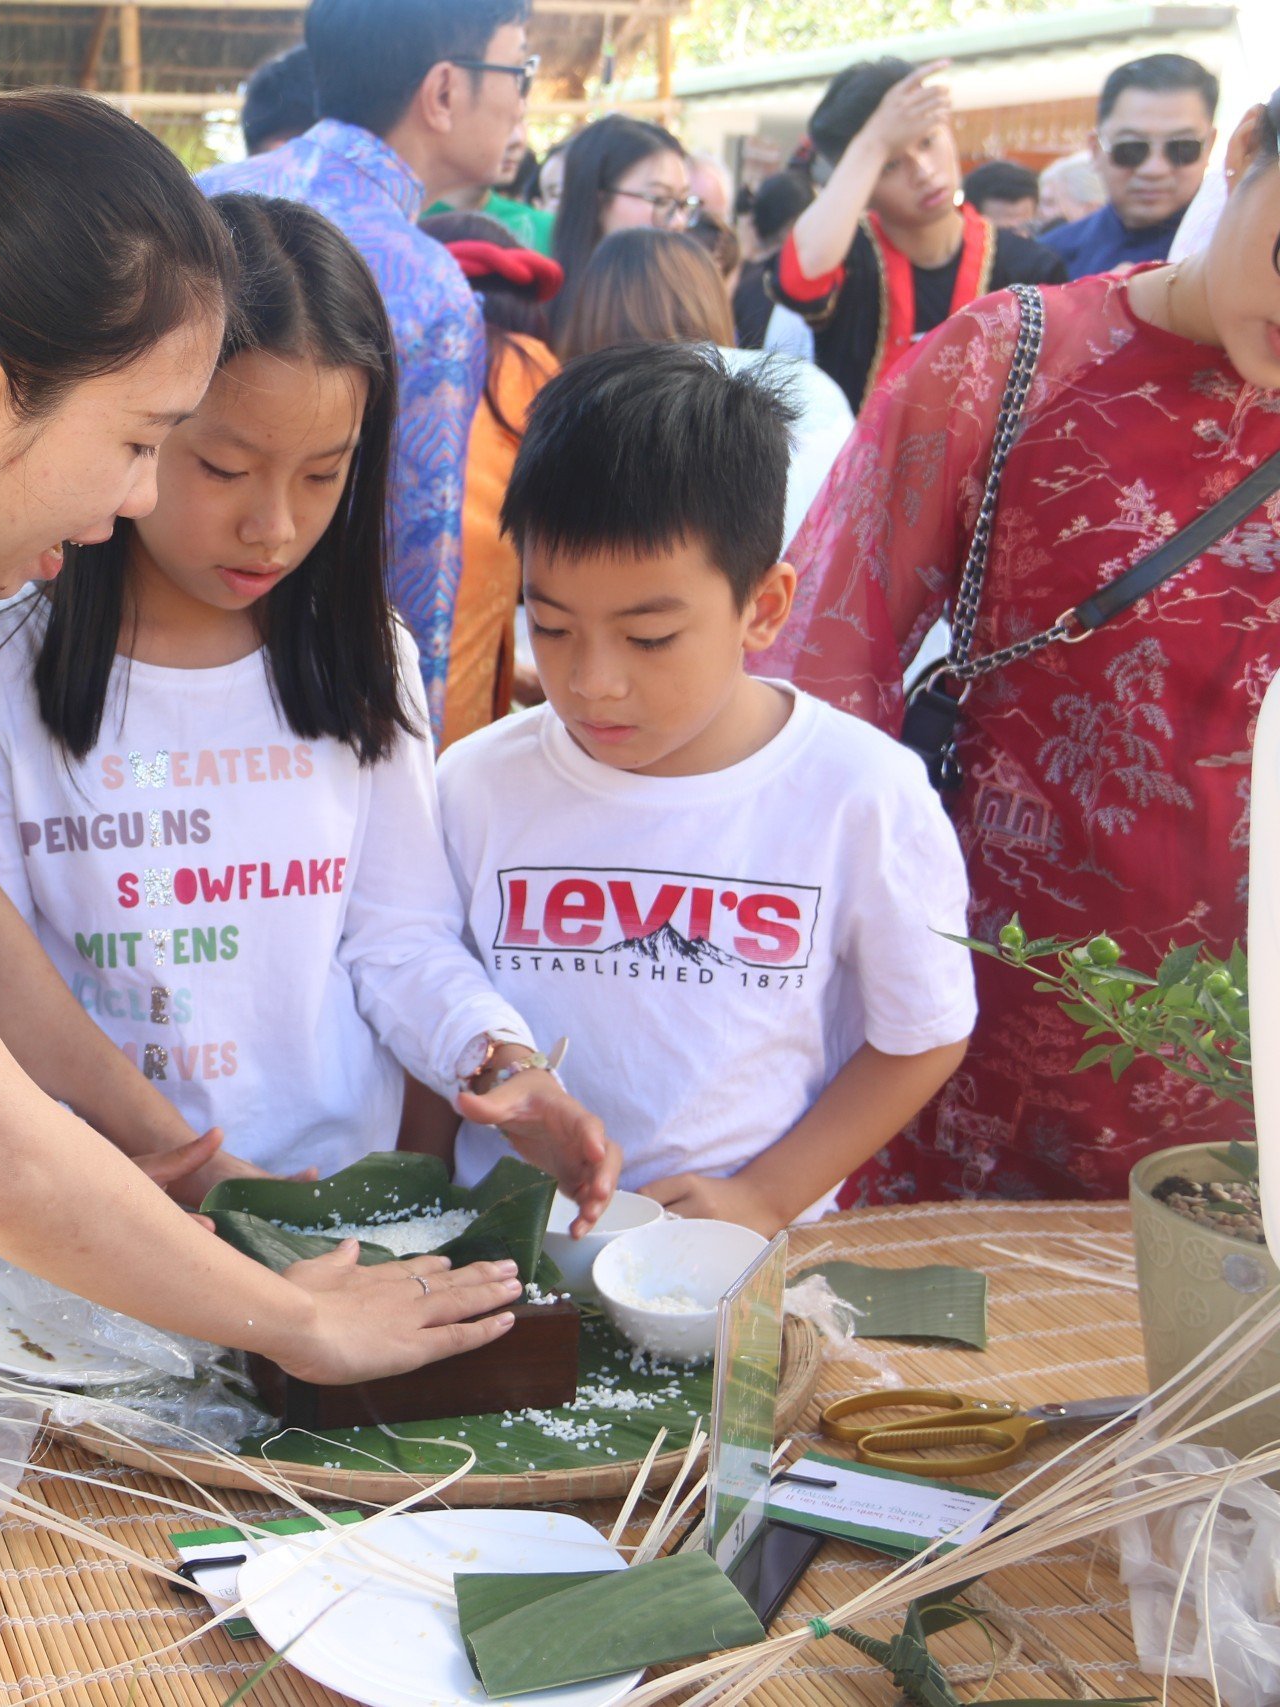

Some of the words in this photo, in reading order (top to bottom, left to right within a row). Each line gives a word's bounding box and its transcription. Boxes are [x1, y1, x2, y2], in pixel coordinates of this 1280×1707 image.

[101, 744, 314, 790] SWEATERS
[19, 808, 212, 856] PENGUINS
[117, 857, 347, 909] SNOWFLAKE
[75, 924, 239, 969] MITTENS
[495, 954, 714, 985] ESTABLISHED
[740, 972, 805, 990] 1873
